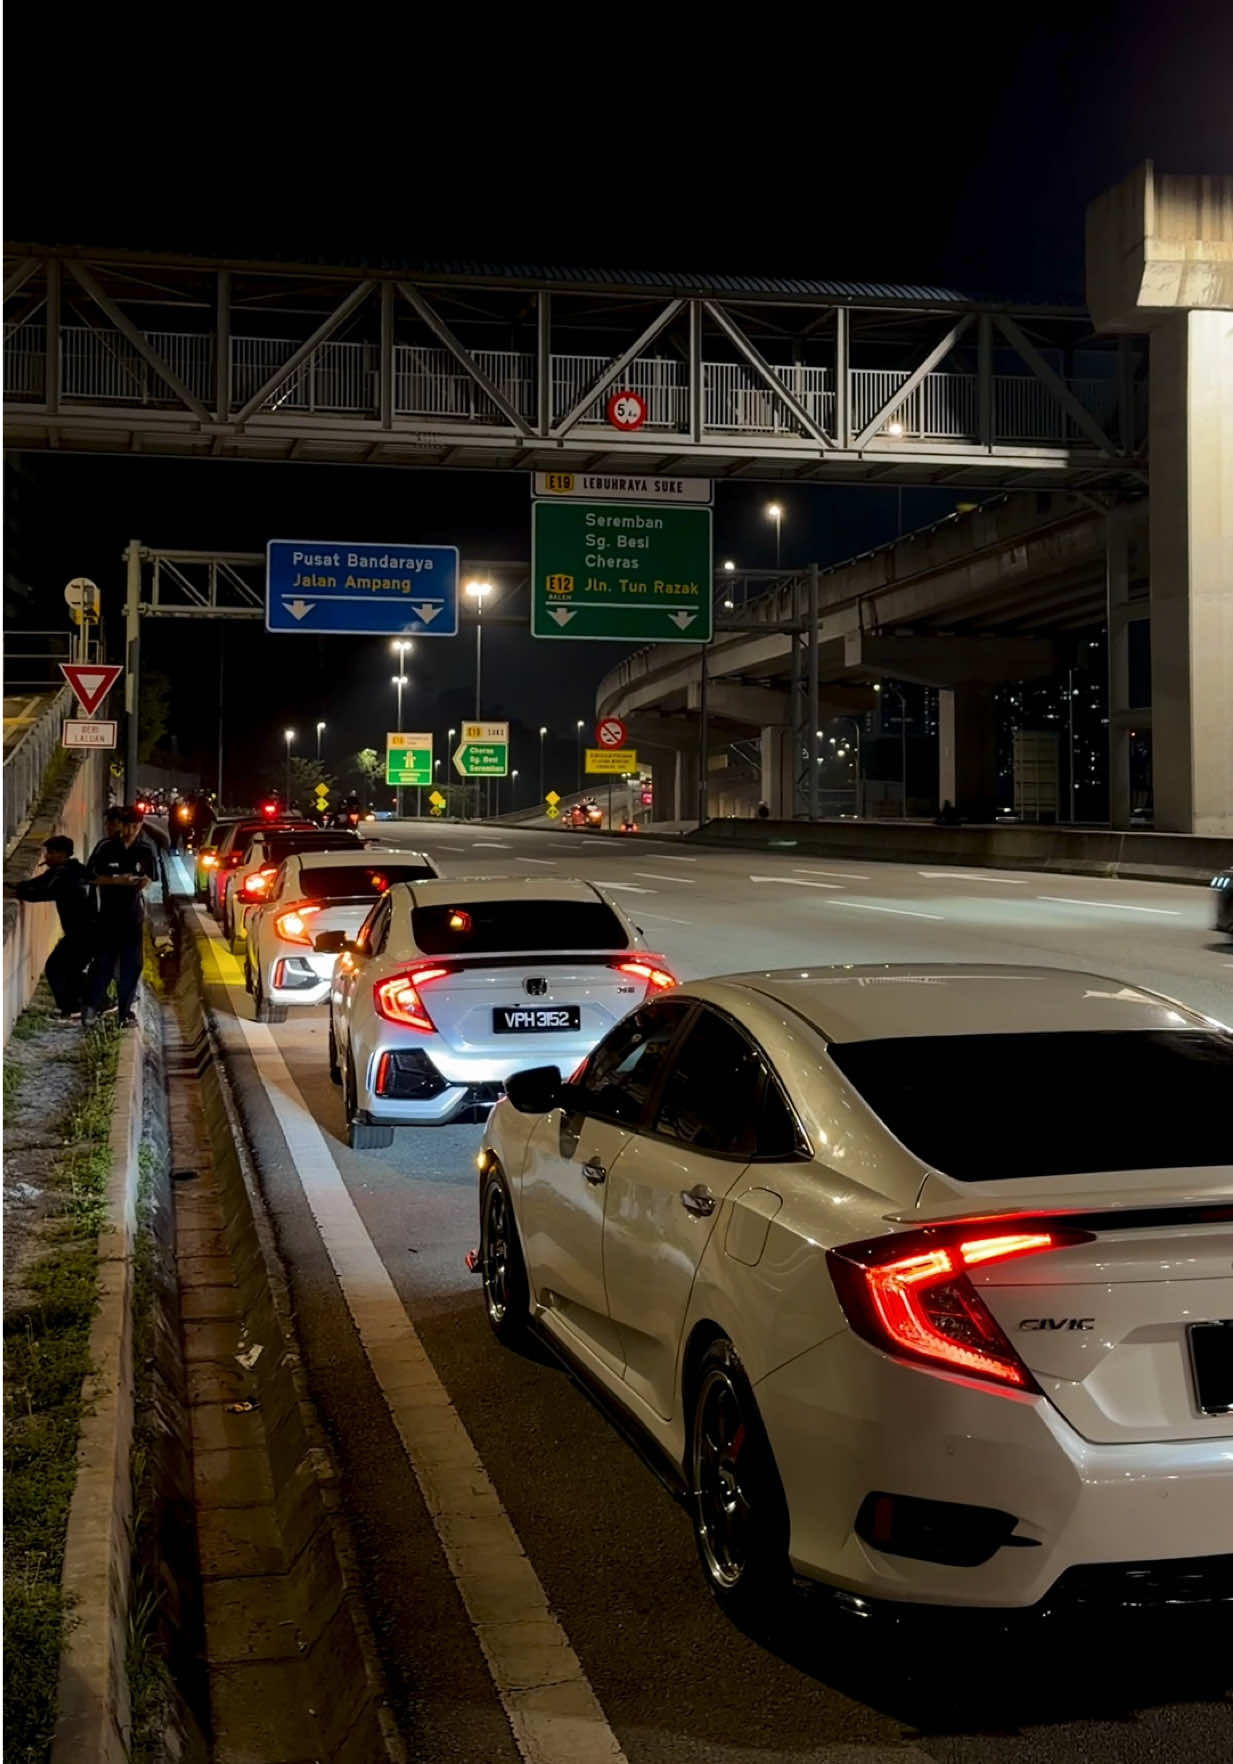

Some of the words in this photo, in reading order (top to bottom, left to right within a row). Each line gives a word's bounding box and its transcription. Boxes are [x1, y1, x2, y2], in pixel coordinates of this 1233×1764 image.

[549, 475, 571, 489] E19
[583, 477, 648, 492] LEBUHRAYA
[653, 480, 683, 493] SUKE
[585, 513, 663, 529] Seremban
[585, 534, 610, 550] Sg.
[617, 535, 649, 548] Besi
[293, 551, 340, 566] Pusat
[347, 553, 434, 573] Bandaraya
[585, 554, 640, 569] Cheras
[293, 572, 337, 588] Jalan
[345, 575, 412, 593] Ampang
[549, 576, 571, 590] E12
[585, 578, 612, 592] Jln.
[619, 579, 647, 593] Tun
[654, 580, 699, 595] Razak
[504, 1011, 535, 1028] VPH
[536, 1011, 570, 1027] 3152
[1018, 1318, 1096, 1331] CIVIC
